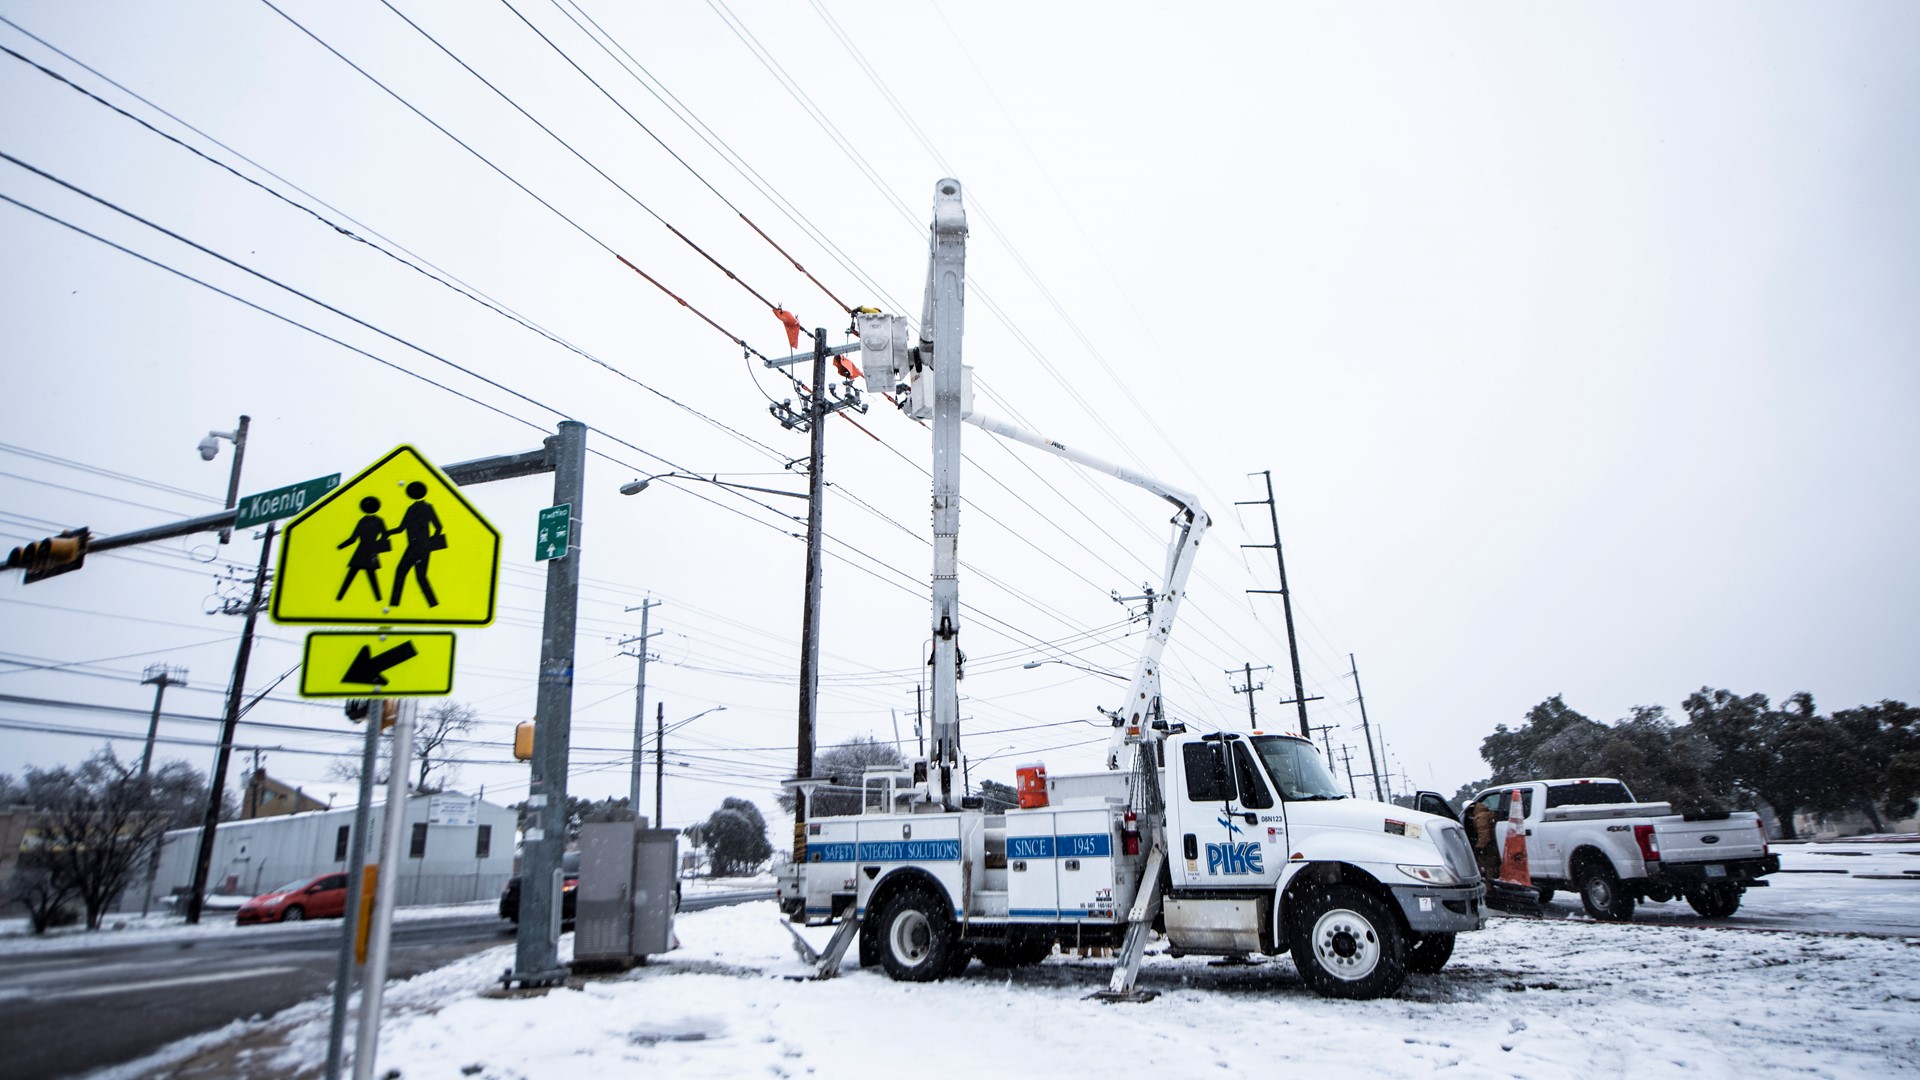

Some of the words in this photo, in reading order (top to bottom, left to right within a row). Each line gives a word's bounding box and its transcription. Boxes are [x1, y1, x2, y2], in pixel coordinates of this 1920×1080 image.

[249, 486, 306, 519] Koenig
[824, 844, 856, 860] SAFETY
[859, 842, 904, 859] INTEGRITY
[907, 841, 959, 858] SOLUTIONS
[1015, 839, 1047, 856] SINCE
[1073, 837, 1096, 854] 1945
[1205, 842, 1265, 875] PIKE
